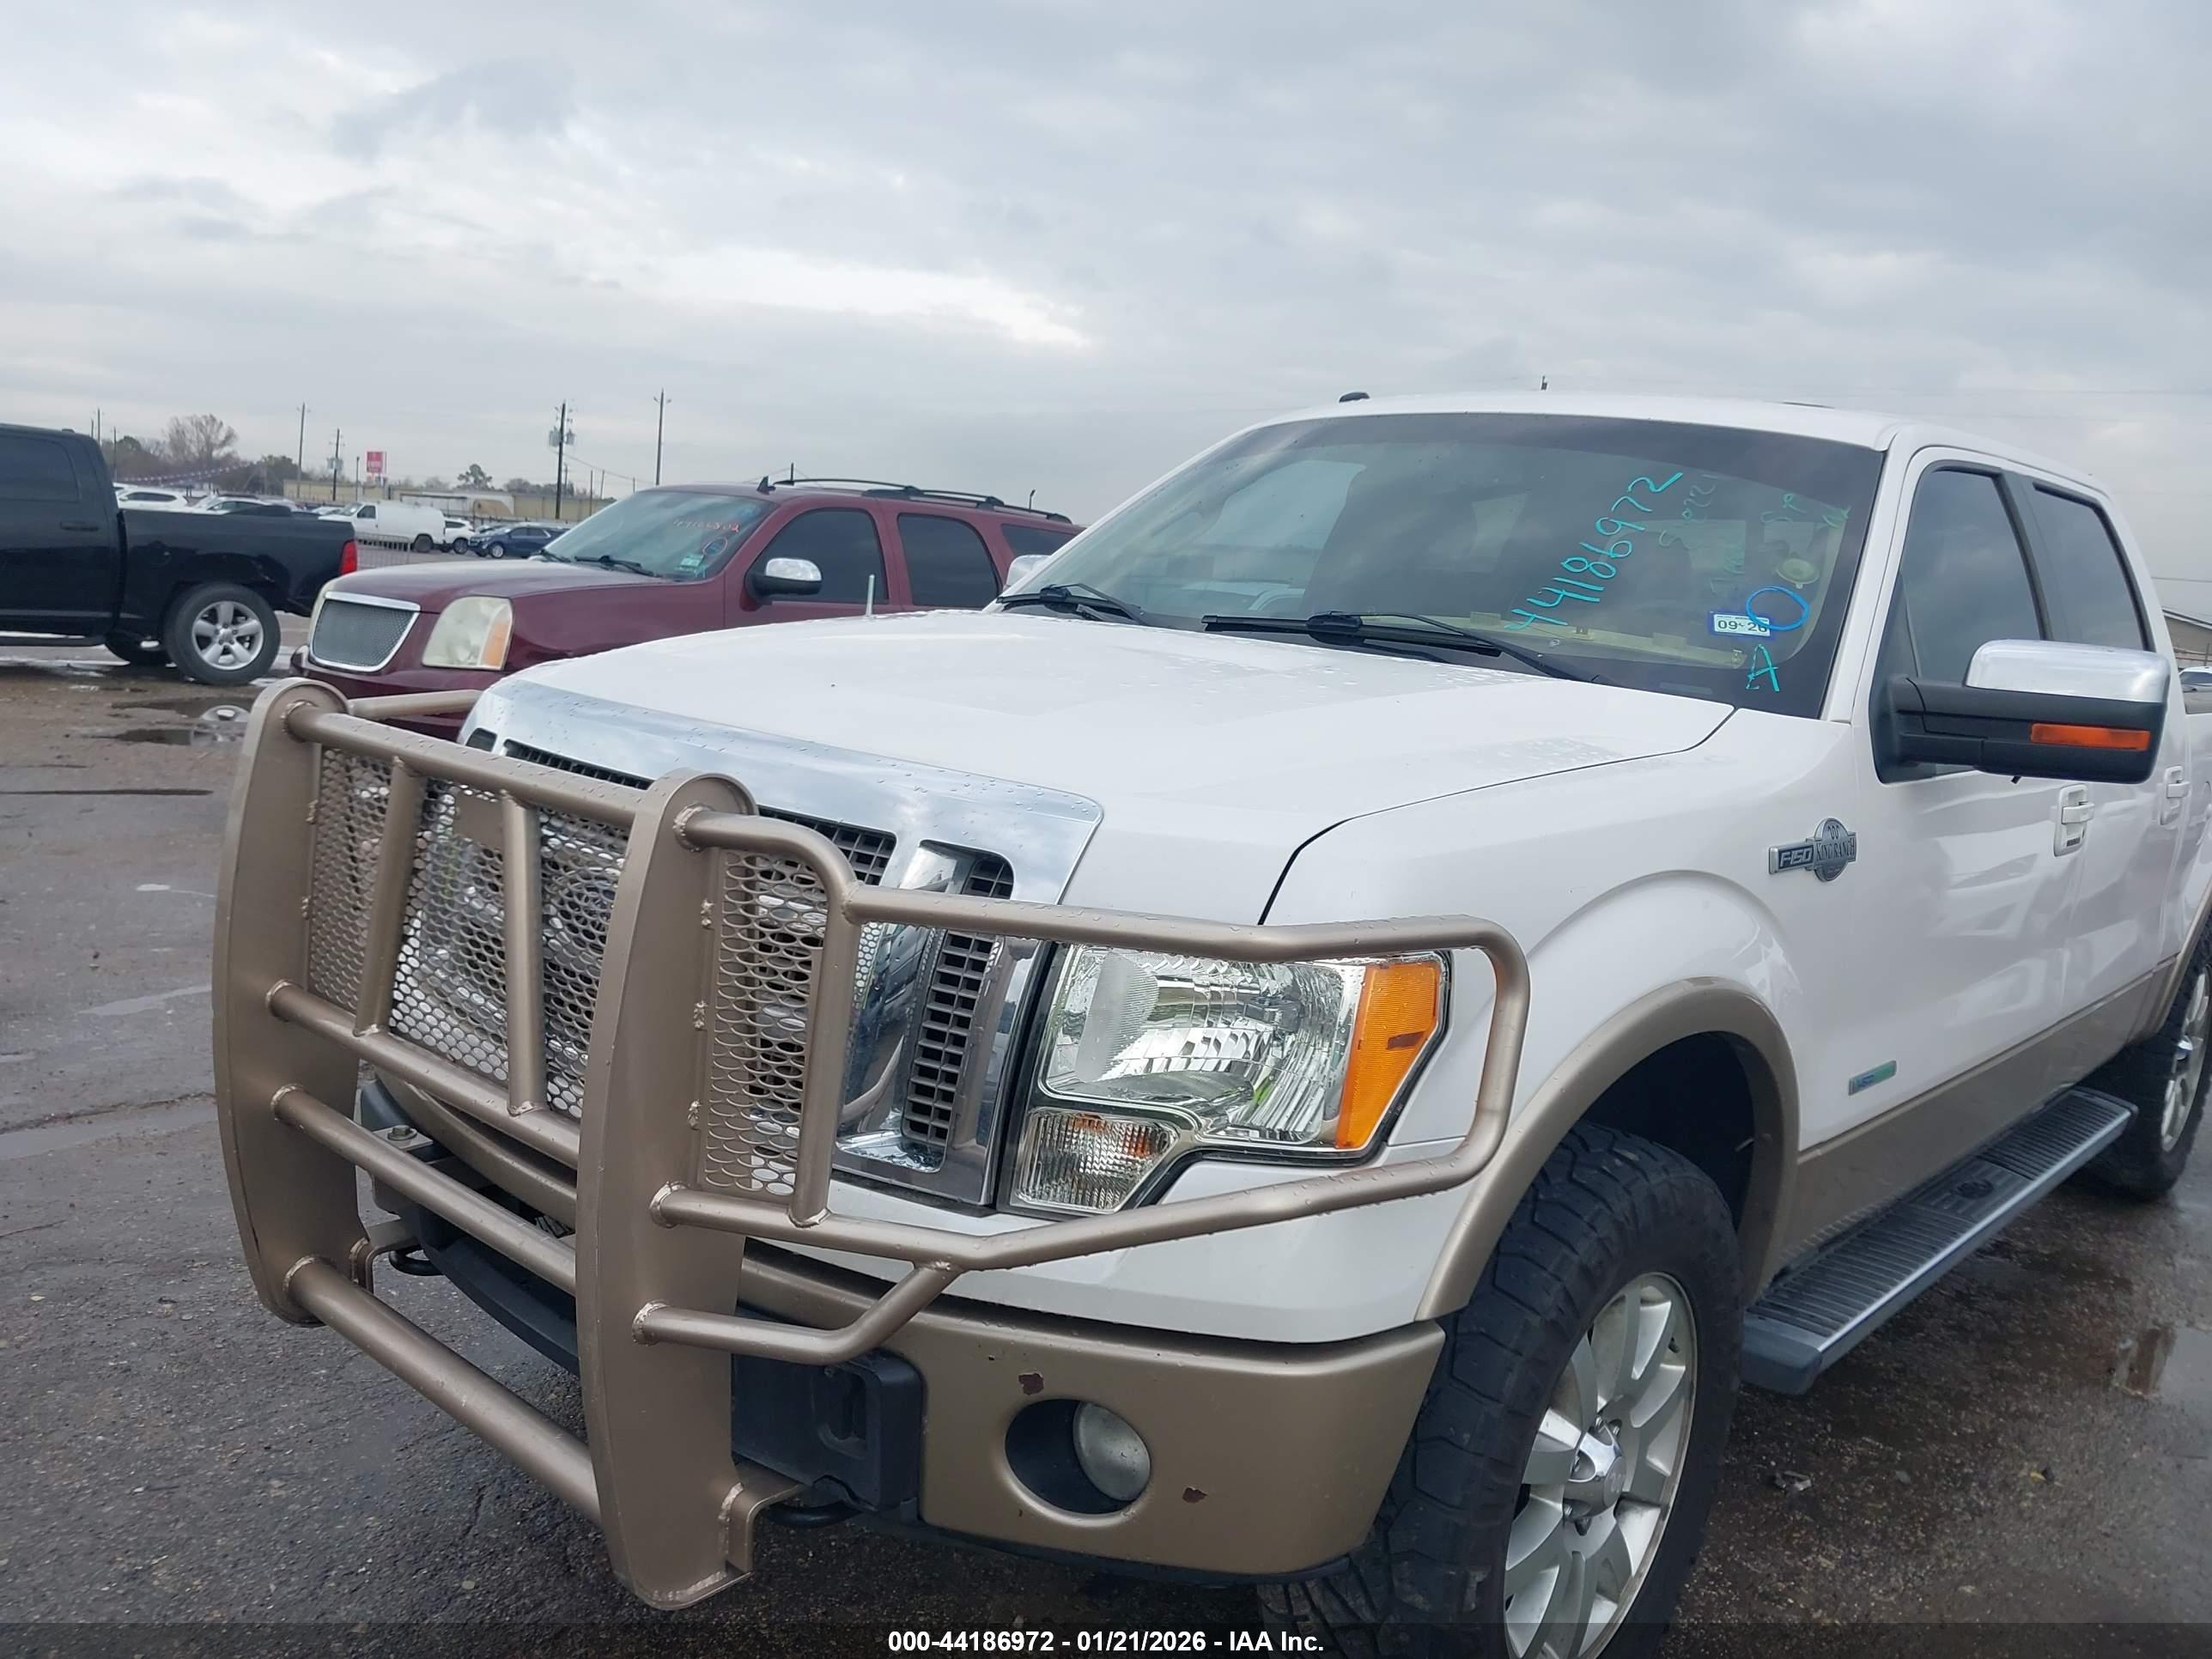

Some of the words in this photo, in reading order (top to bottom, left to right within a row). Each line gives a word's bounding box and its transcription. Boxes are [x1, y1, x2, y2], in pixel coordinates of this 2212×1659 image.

[1504, 471, 1683, 630] 44186972
[1745, 643, 1780, 692] A
[1816, 842, 1833, 860] KING
[1834, 837, 1855, 859] RANCH
